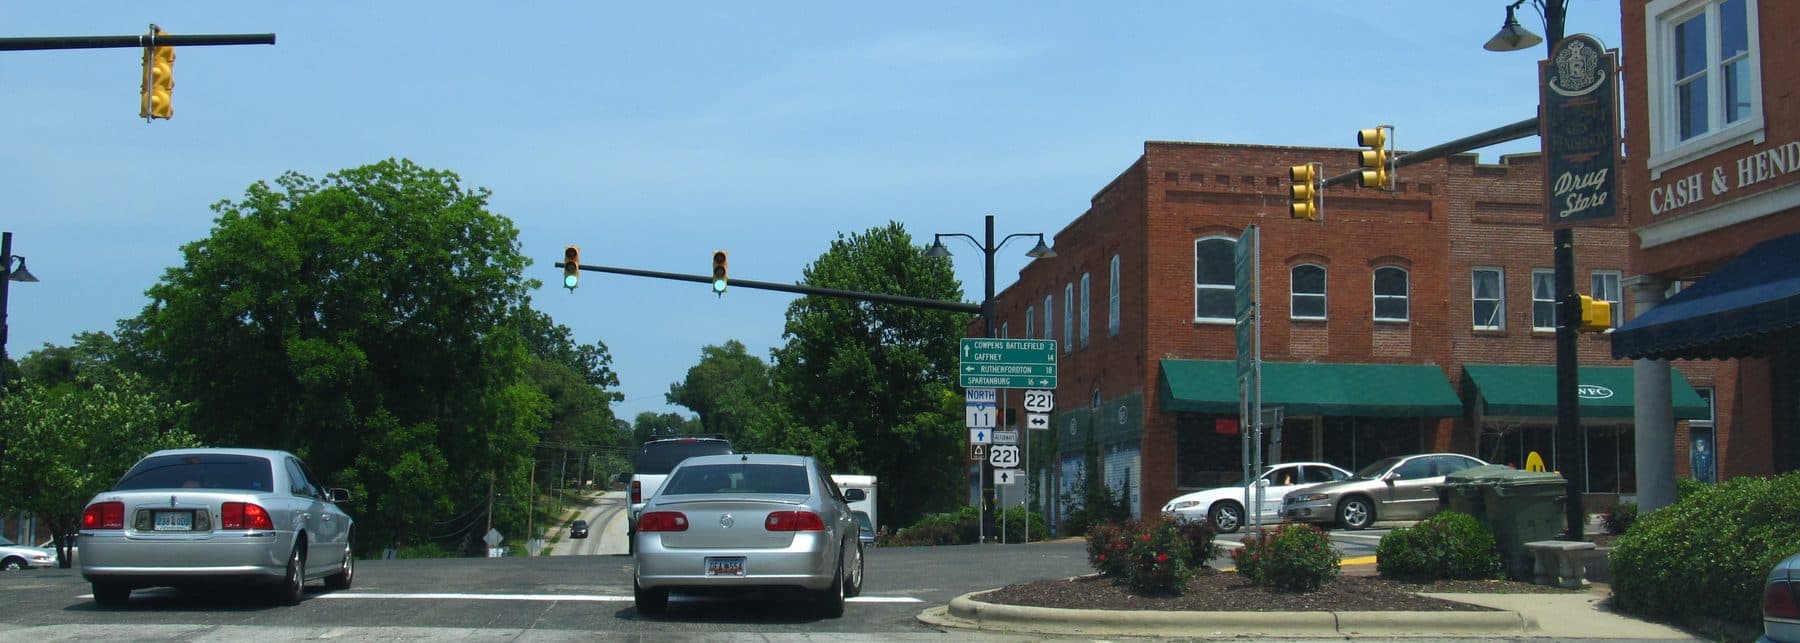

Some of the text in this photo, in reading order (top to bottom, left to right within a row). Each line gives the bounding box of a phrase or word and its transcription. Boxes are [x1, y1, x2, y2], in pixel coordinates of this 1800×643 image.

[1554, 168, 1608, 197] Drug
[1650, 141, 1800, 215] CASH & HEND
[1560, 191, 1608, 217] Store
[974, 341, 1004, 349] COWPENS
[1005, 342, 1045, 350] BATTLEFIELD
[974, 353, 1054, 362] GAFFNEY 14
[980, 365, 1032, 374] RUTHERFORDTON
[967, 377, 1010, 385] SPARTANBURG
[967, 389, 995, 400] NORTH
[1026, 393, 1052, 408] 221
[973, 412, 989, 427] 11
[992, 449, 1017, 463] 221
